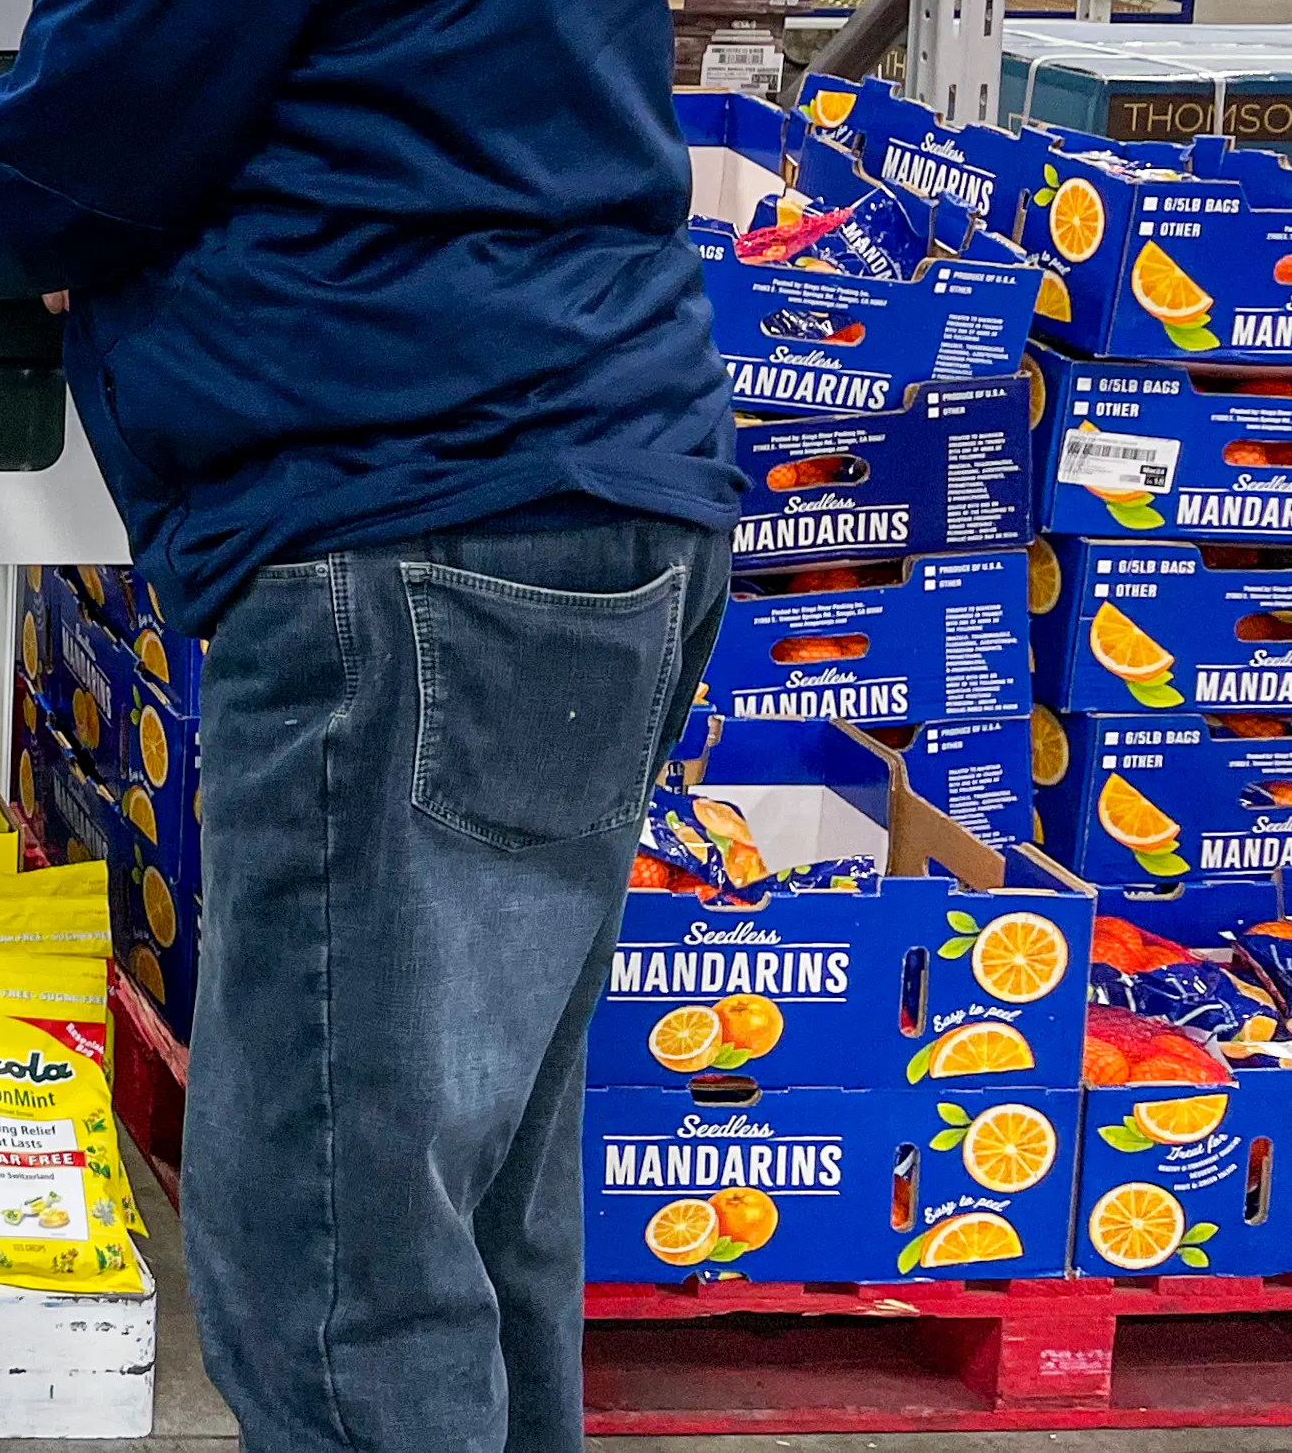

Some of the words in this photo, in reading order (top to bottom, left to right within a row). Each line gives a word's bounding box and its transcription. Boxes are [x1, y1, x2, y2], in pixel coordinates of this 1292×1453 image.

[1205, 198, 1241, 214] BAGS
[1159, 221, 1201, 238] OTHER
[782, 492, 857, 516] Seedless
[732, 511, 911, 554] MANDARINS
[683, 921, 782, 949] Seedless
[608, 950, 850, 996] MANDARINS
[933, 1005, 966, 1032] Easy
[968, 1003, 982, 1018] to
[984, 1004, 1024, 1024] peel
[676, 1114, 775, 1141] Seedless
[603, 1143, 843, 1189] MANDARINS
